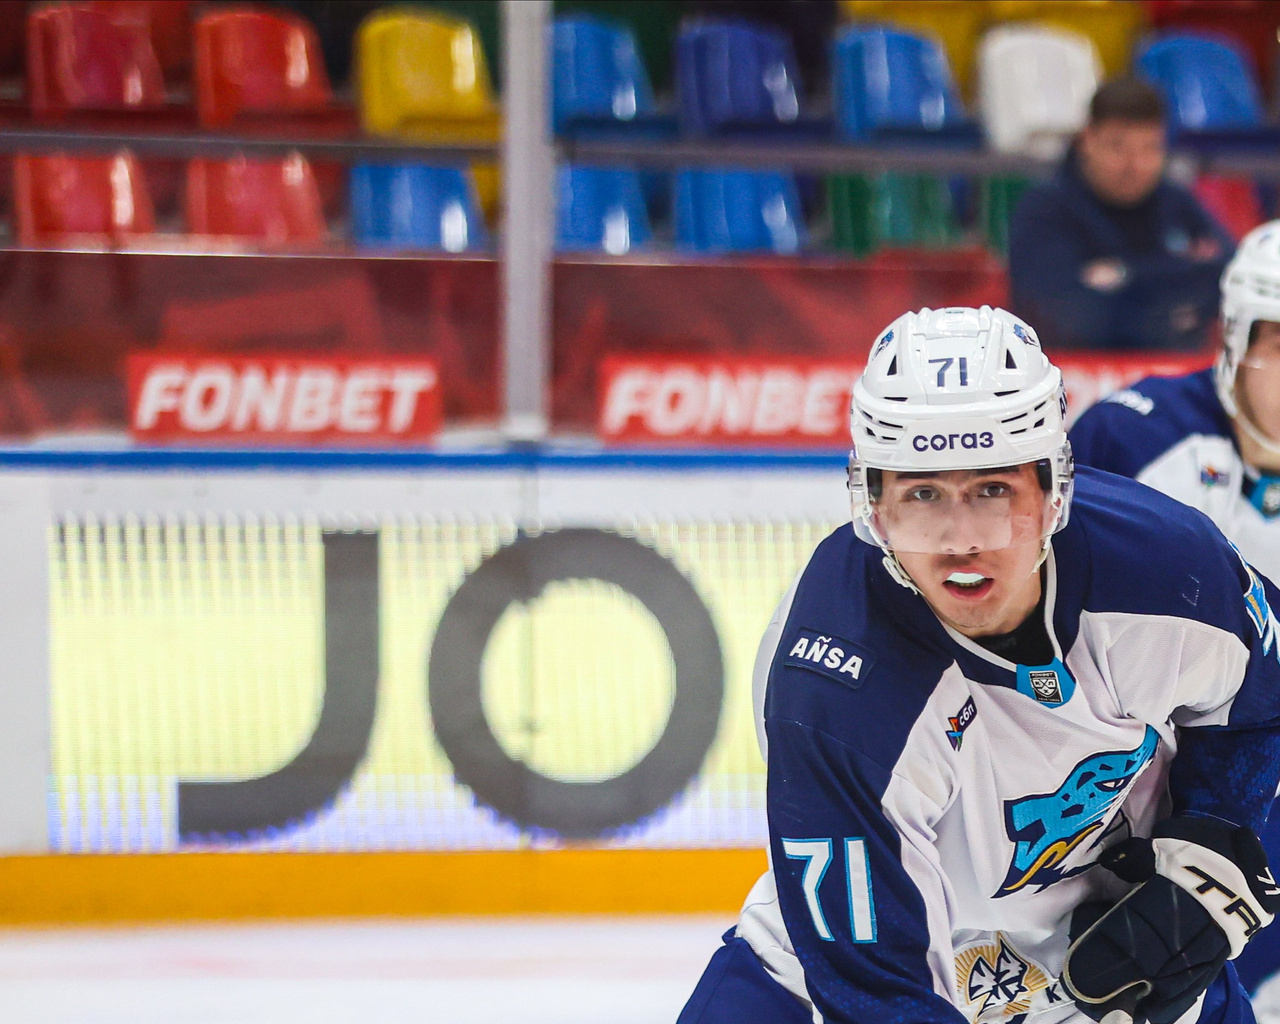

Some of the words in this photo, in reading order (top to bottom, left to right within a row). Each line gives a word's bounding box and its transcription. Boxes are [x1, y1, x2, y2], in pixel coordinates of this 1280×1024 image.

[135, 361, 437, 434] FONBET
[602, 366, 858, 436] FONBE
[928, 357, 968, 388] 71
[789, 635, 863, 680] AÑSA
[781, 836, 878, 943] 71
